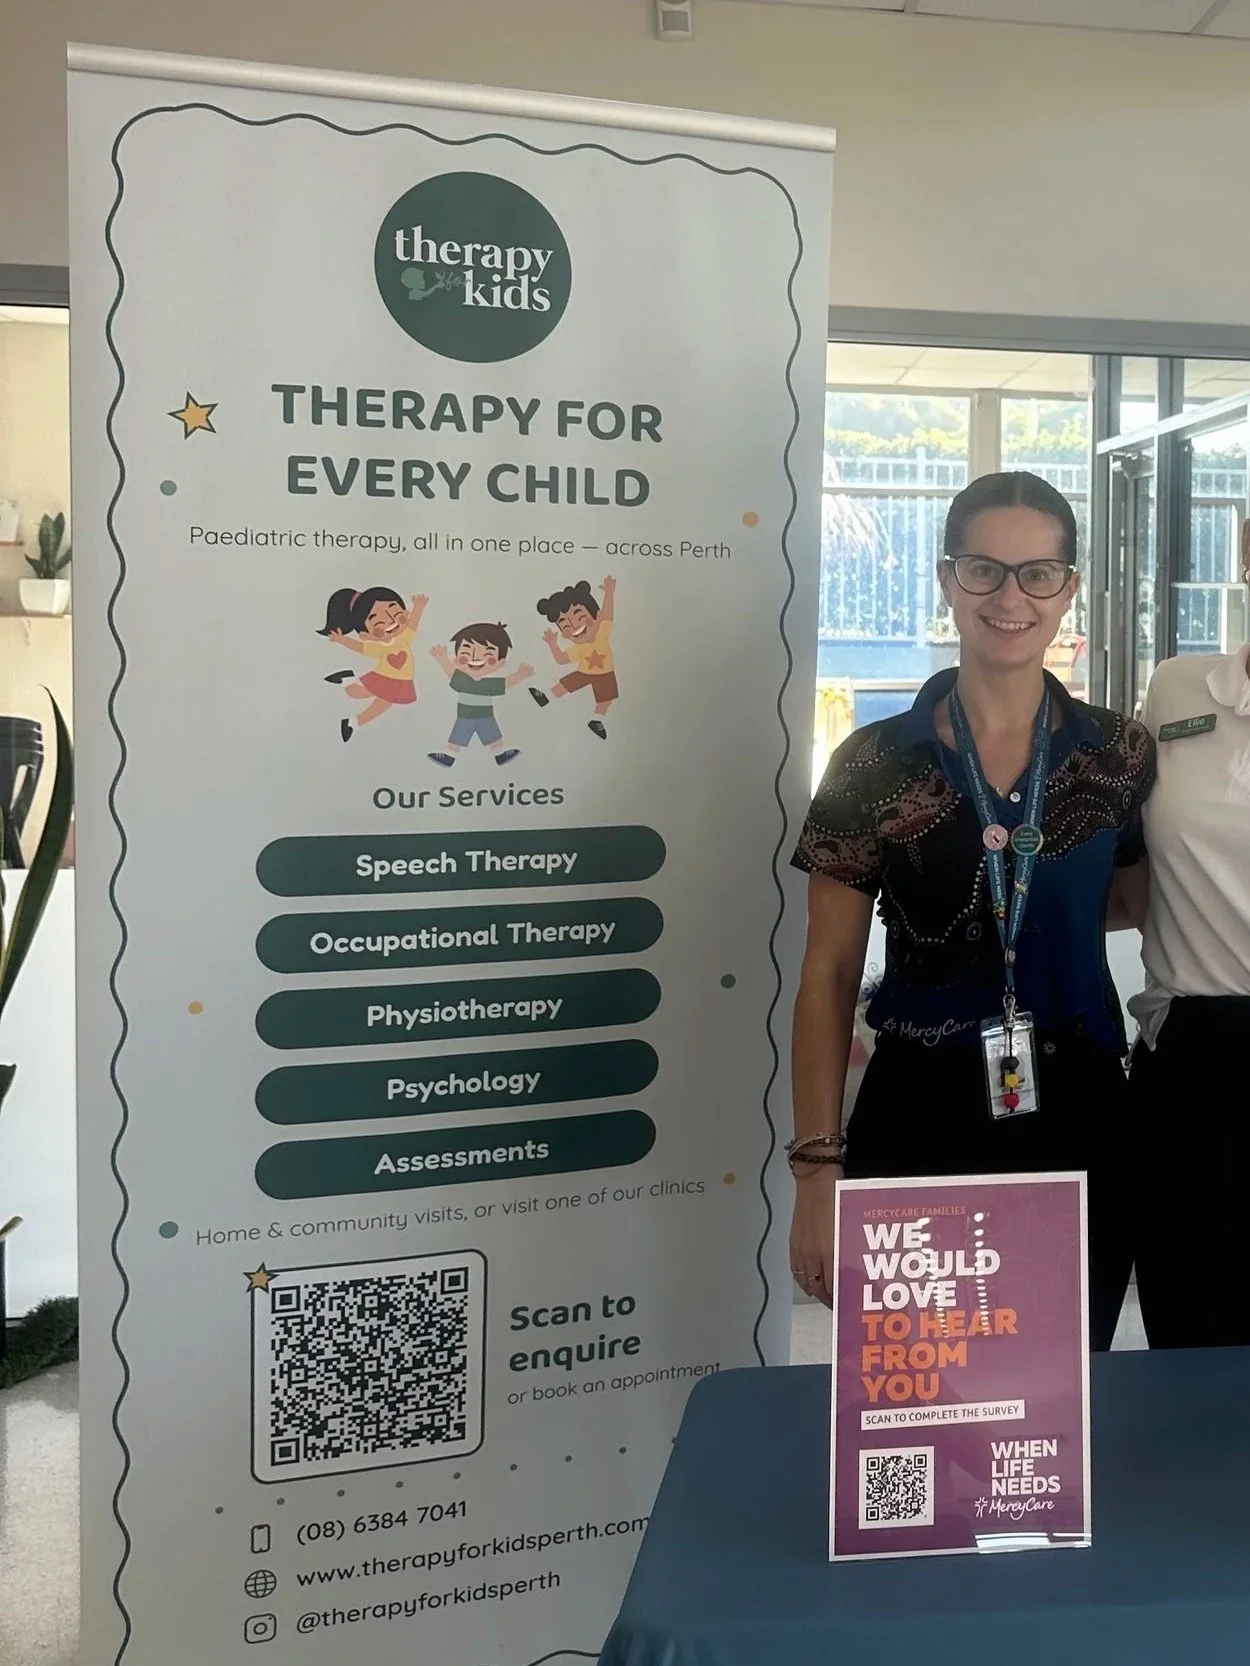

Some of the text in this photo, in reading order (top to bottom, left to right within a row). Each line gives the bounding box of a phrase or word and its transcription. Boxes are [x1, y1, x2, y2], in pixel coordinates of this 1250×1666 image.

[394, 225, 554, 282] therapy
[463, 269, 551, 312] kids
[271, 384, 662, 443] THERAPY FOR
[288, 456, 649, 507] EVERY CHILD
[191, 527, 306, 547] Paediatric
[313, 529, 406, 553] therapy,
[414, 532, 437, 550] all
[446, 535, 463, 551] in
[471, 539, 511, 552] one
[519, 536, 574, 556] place
[606, 543, 672, 557] across
[681, 541, 730, 559] Perth
[373, 783, 564, 809] Our Services
[357, 850, 577, 881] Speech Therapy
[310, 920, 616, 956] Occupational Therapy
[368, 999, 562, 1030] Physiotherapy
[388, 1071, 540, 1103] Psychology
[374, 1141, 548, 1174] Assessments
[197, 1179, 705, 1246] Home & community visits, or visit one of our clinics
[864, 1205, 966, 1219] MERCYCARE FAMILIES
[863, 1223, 922, 1250] WE
[862, 1249, 1000, 1280] WOULD
[862, 1280, 956, 1311] LOVE
[510, 1296, 635, 1331] Scan to
[862, 1308, 1018, 1341] TO HEAR
[510, 1334, 640, 1371] enquire
[862, 1341, 967, 1372] FROM
[508, 1362, 720, 1404] or book an appointment
[861, 1373, 940, 1402] YOU
[866, 1405, 1018, 1424] SCAN TO COMPLETE THE SURVEY
[991, 1439, 1057, 1459] WHEN
[991, 1459, 1034, 1478] LIFE
[991, 1475, 1061, 1496] NEEDS
[297, 1500, 467, 1545] (08) 6384 7041
[988, 1497, 1055, 1520] MercyCare
[297, 1517, 651, 1588] www.therapyforkidsperth.com
[296, 1570, 561, 1634] @therapyforkidsperth
